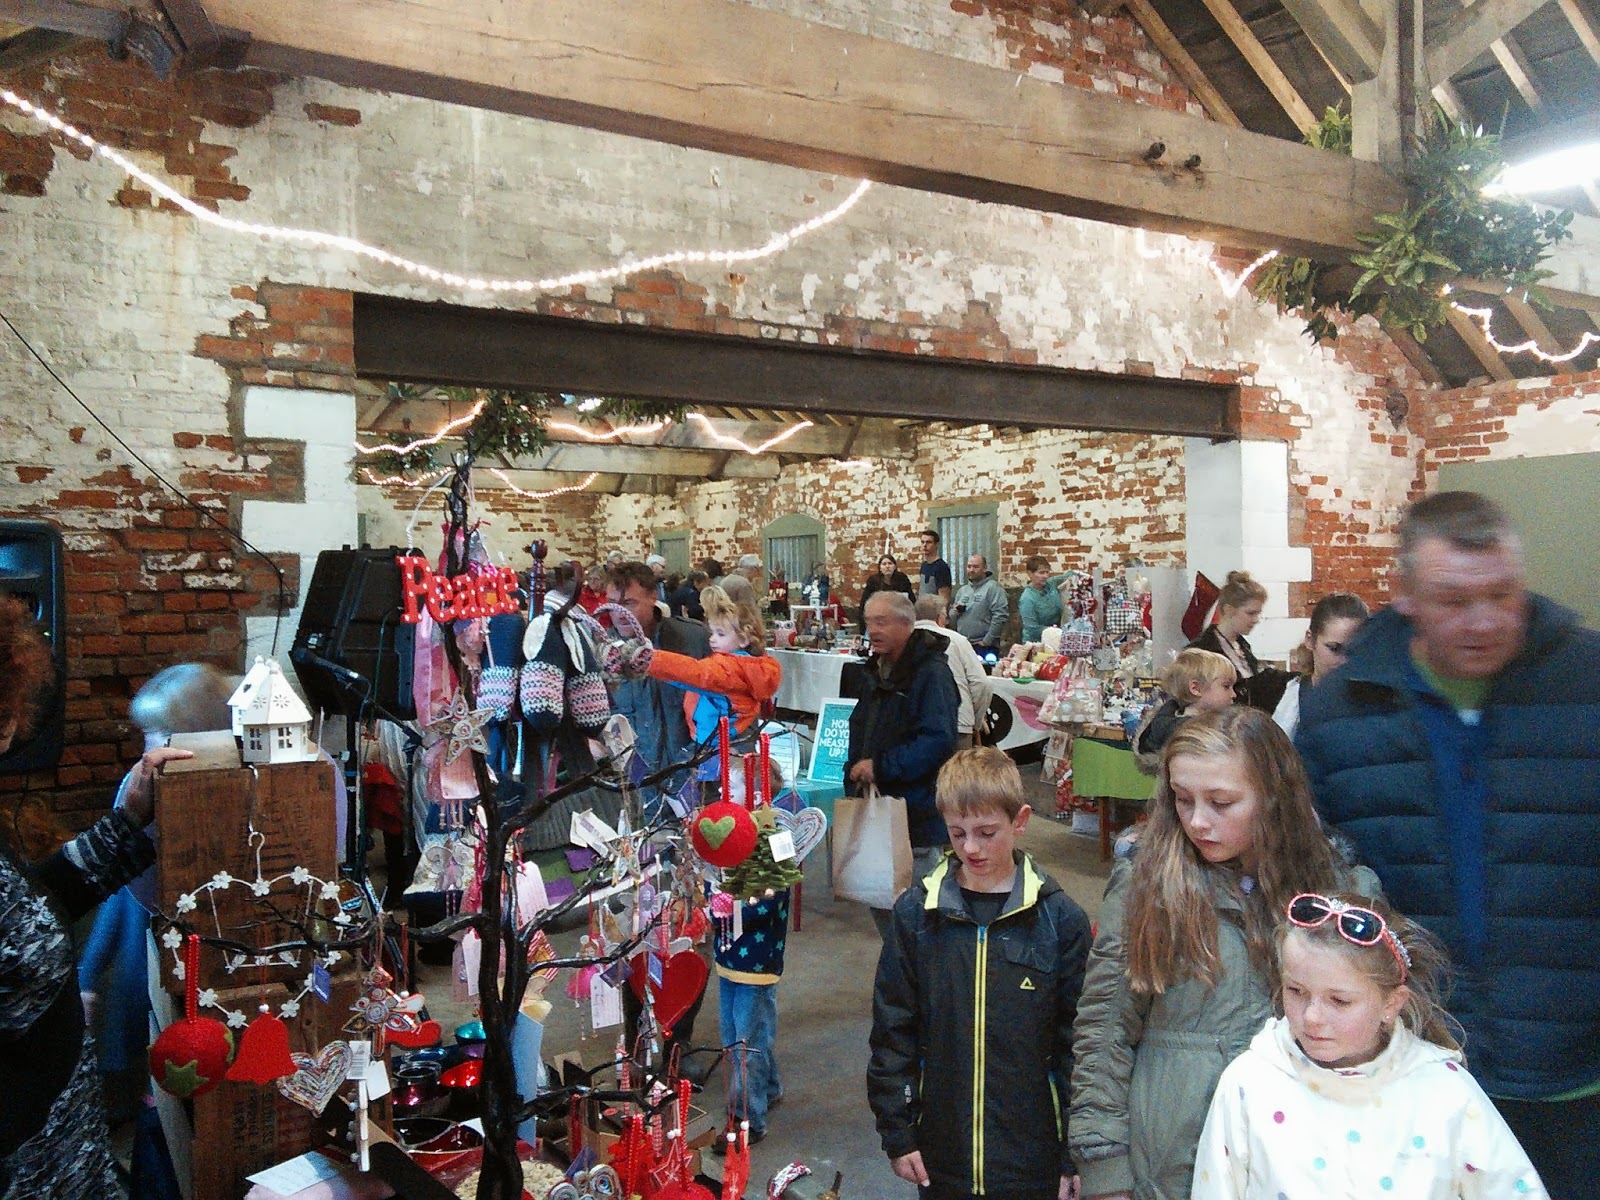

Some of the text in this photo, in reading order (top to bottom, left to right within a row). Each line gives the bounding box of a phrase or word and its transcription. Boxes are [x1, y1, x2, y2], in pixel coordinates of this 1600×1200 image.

[824, 727, 850, 739] DO YO
[828, 747, 846, 758] UP?
